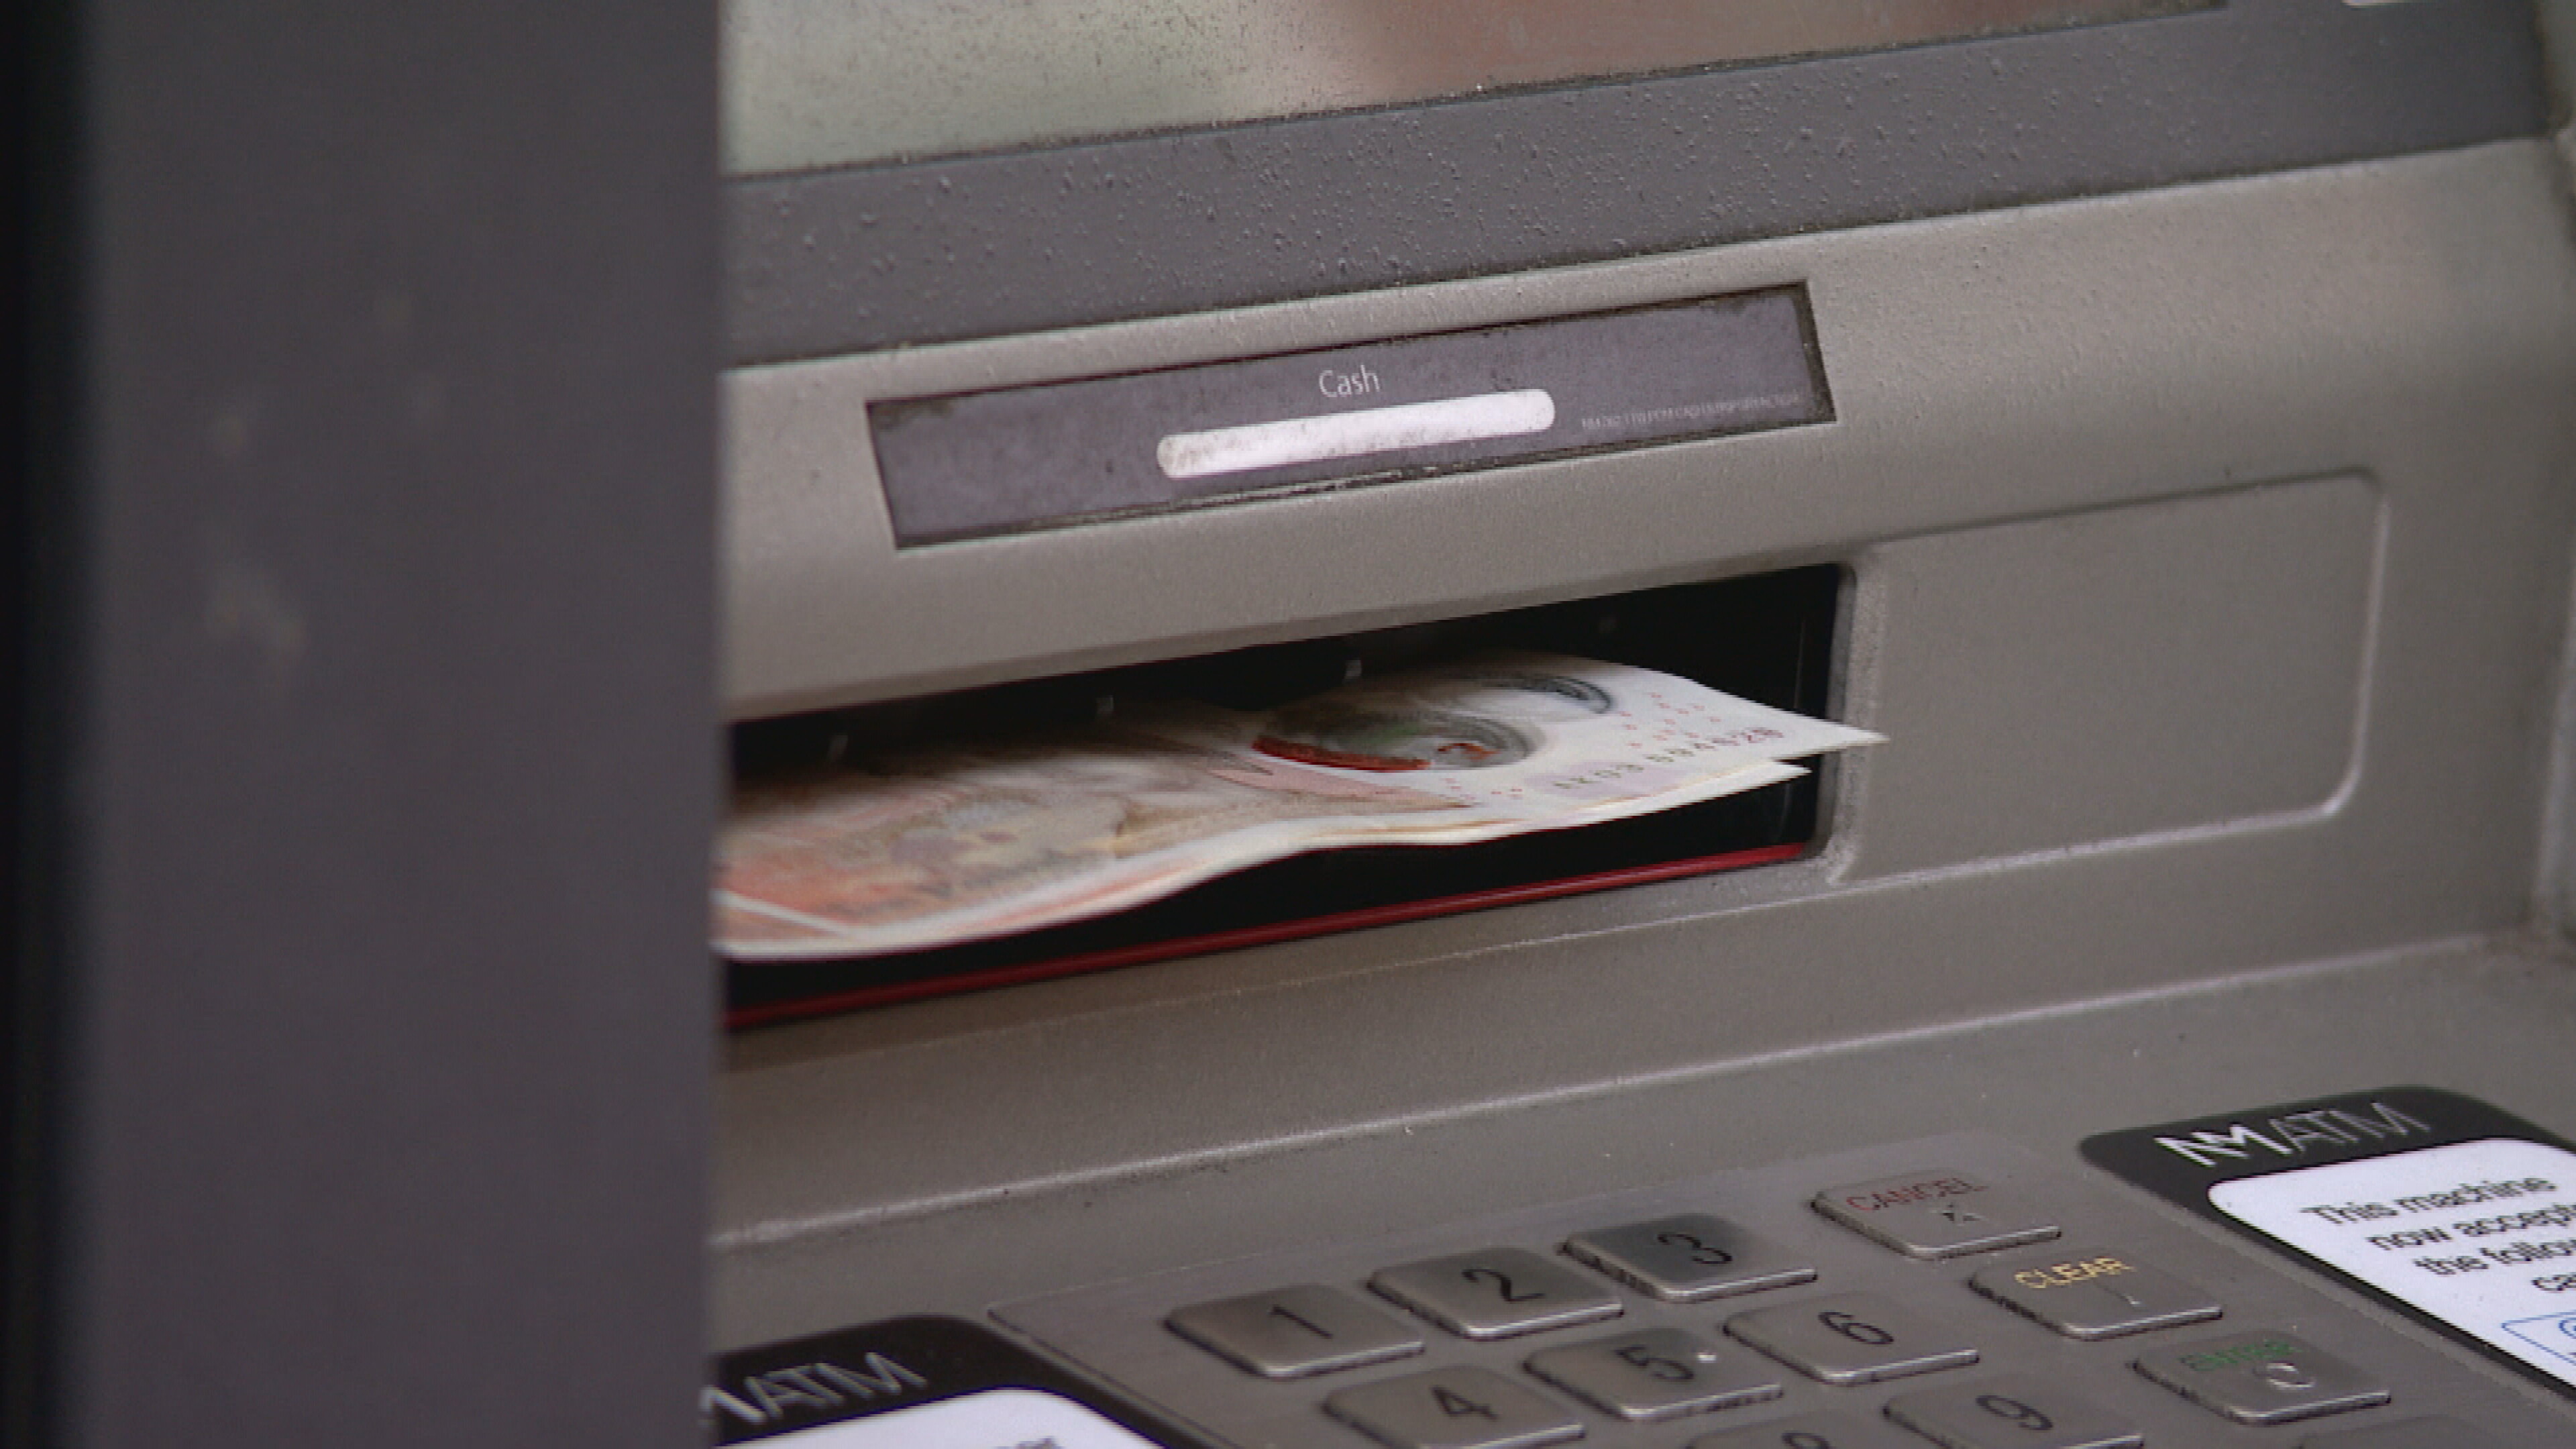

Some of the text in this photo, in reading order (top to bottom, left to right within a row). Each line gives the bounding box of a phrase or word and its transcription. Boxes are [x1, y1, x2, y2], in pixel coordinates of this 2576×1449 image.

[1318, 364, 1381, 398] Cash
[1845, 1177, 1990, 1211] CANCEL
[2300, 1177, 2560, 1225] This machine
[2365, 1203, 2575, 1250] now accep
[1656, 1232, 1733, 1267] 3
[2413, 1237, 2575, 1276] the follo
[1460, 1267, 1546, 1303] 2
[2014, 1255, 2139, 1289] CLEAR
[1267, 1303, 1335, 1339] 1
[1817, 1311, 1895, 1345] 6
[1614, 1344, 1695, 1382] 5
[1429, 1385, 1500, 1421] 4
[1974, 1394, 2054, 1432] 9
